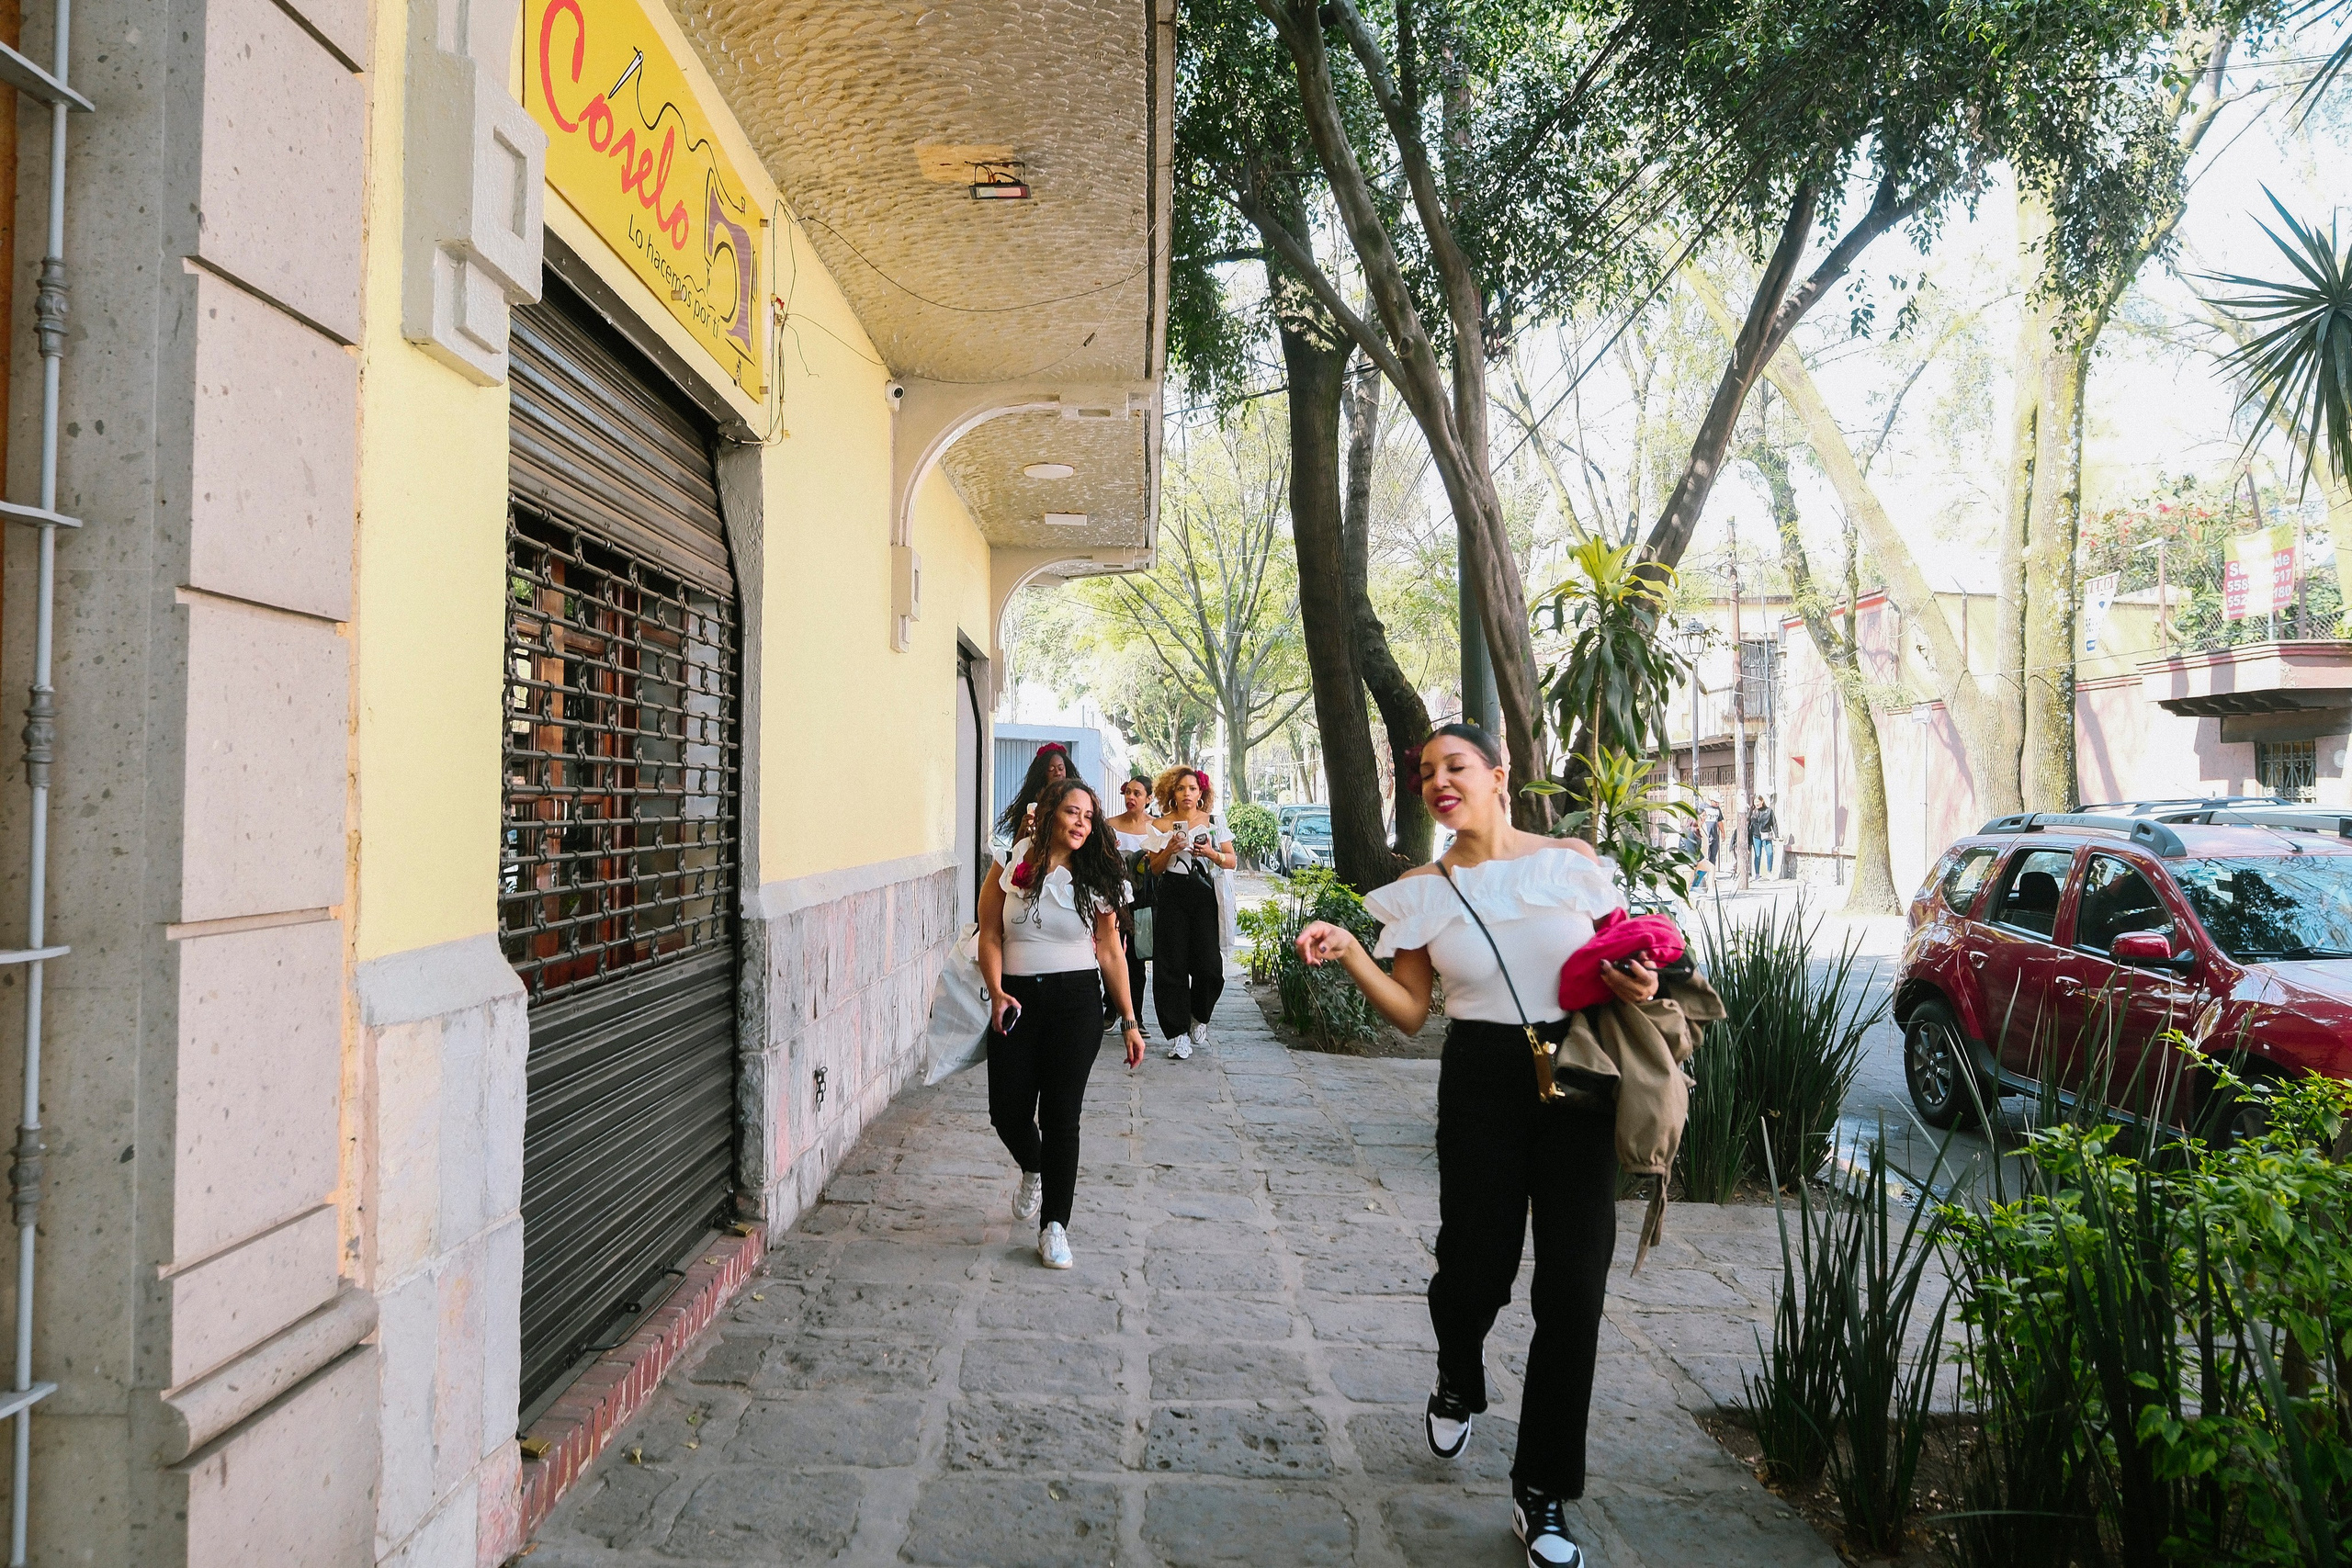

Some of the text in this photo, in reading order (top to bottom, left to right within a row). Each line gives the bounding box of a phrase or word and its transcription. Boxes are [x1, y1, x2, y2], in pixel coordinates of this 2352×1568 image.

[628, 214, 720, 339] Lo hacemos por ti
